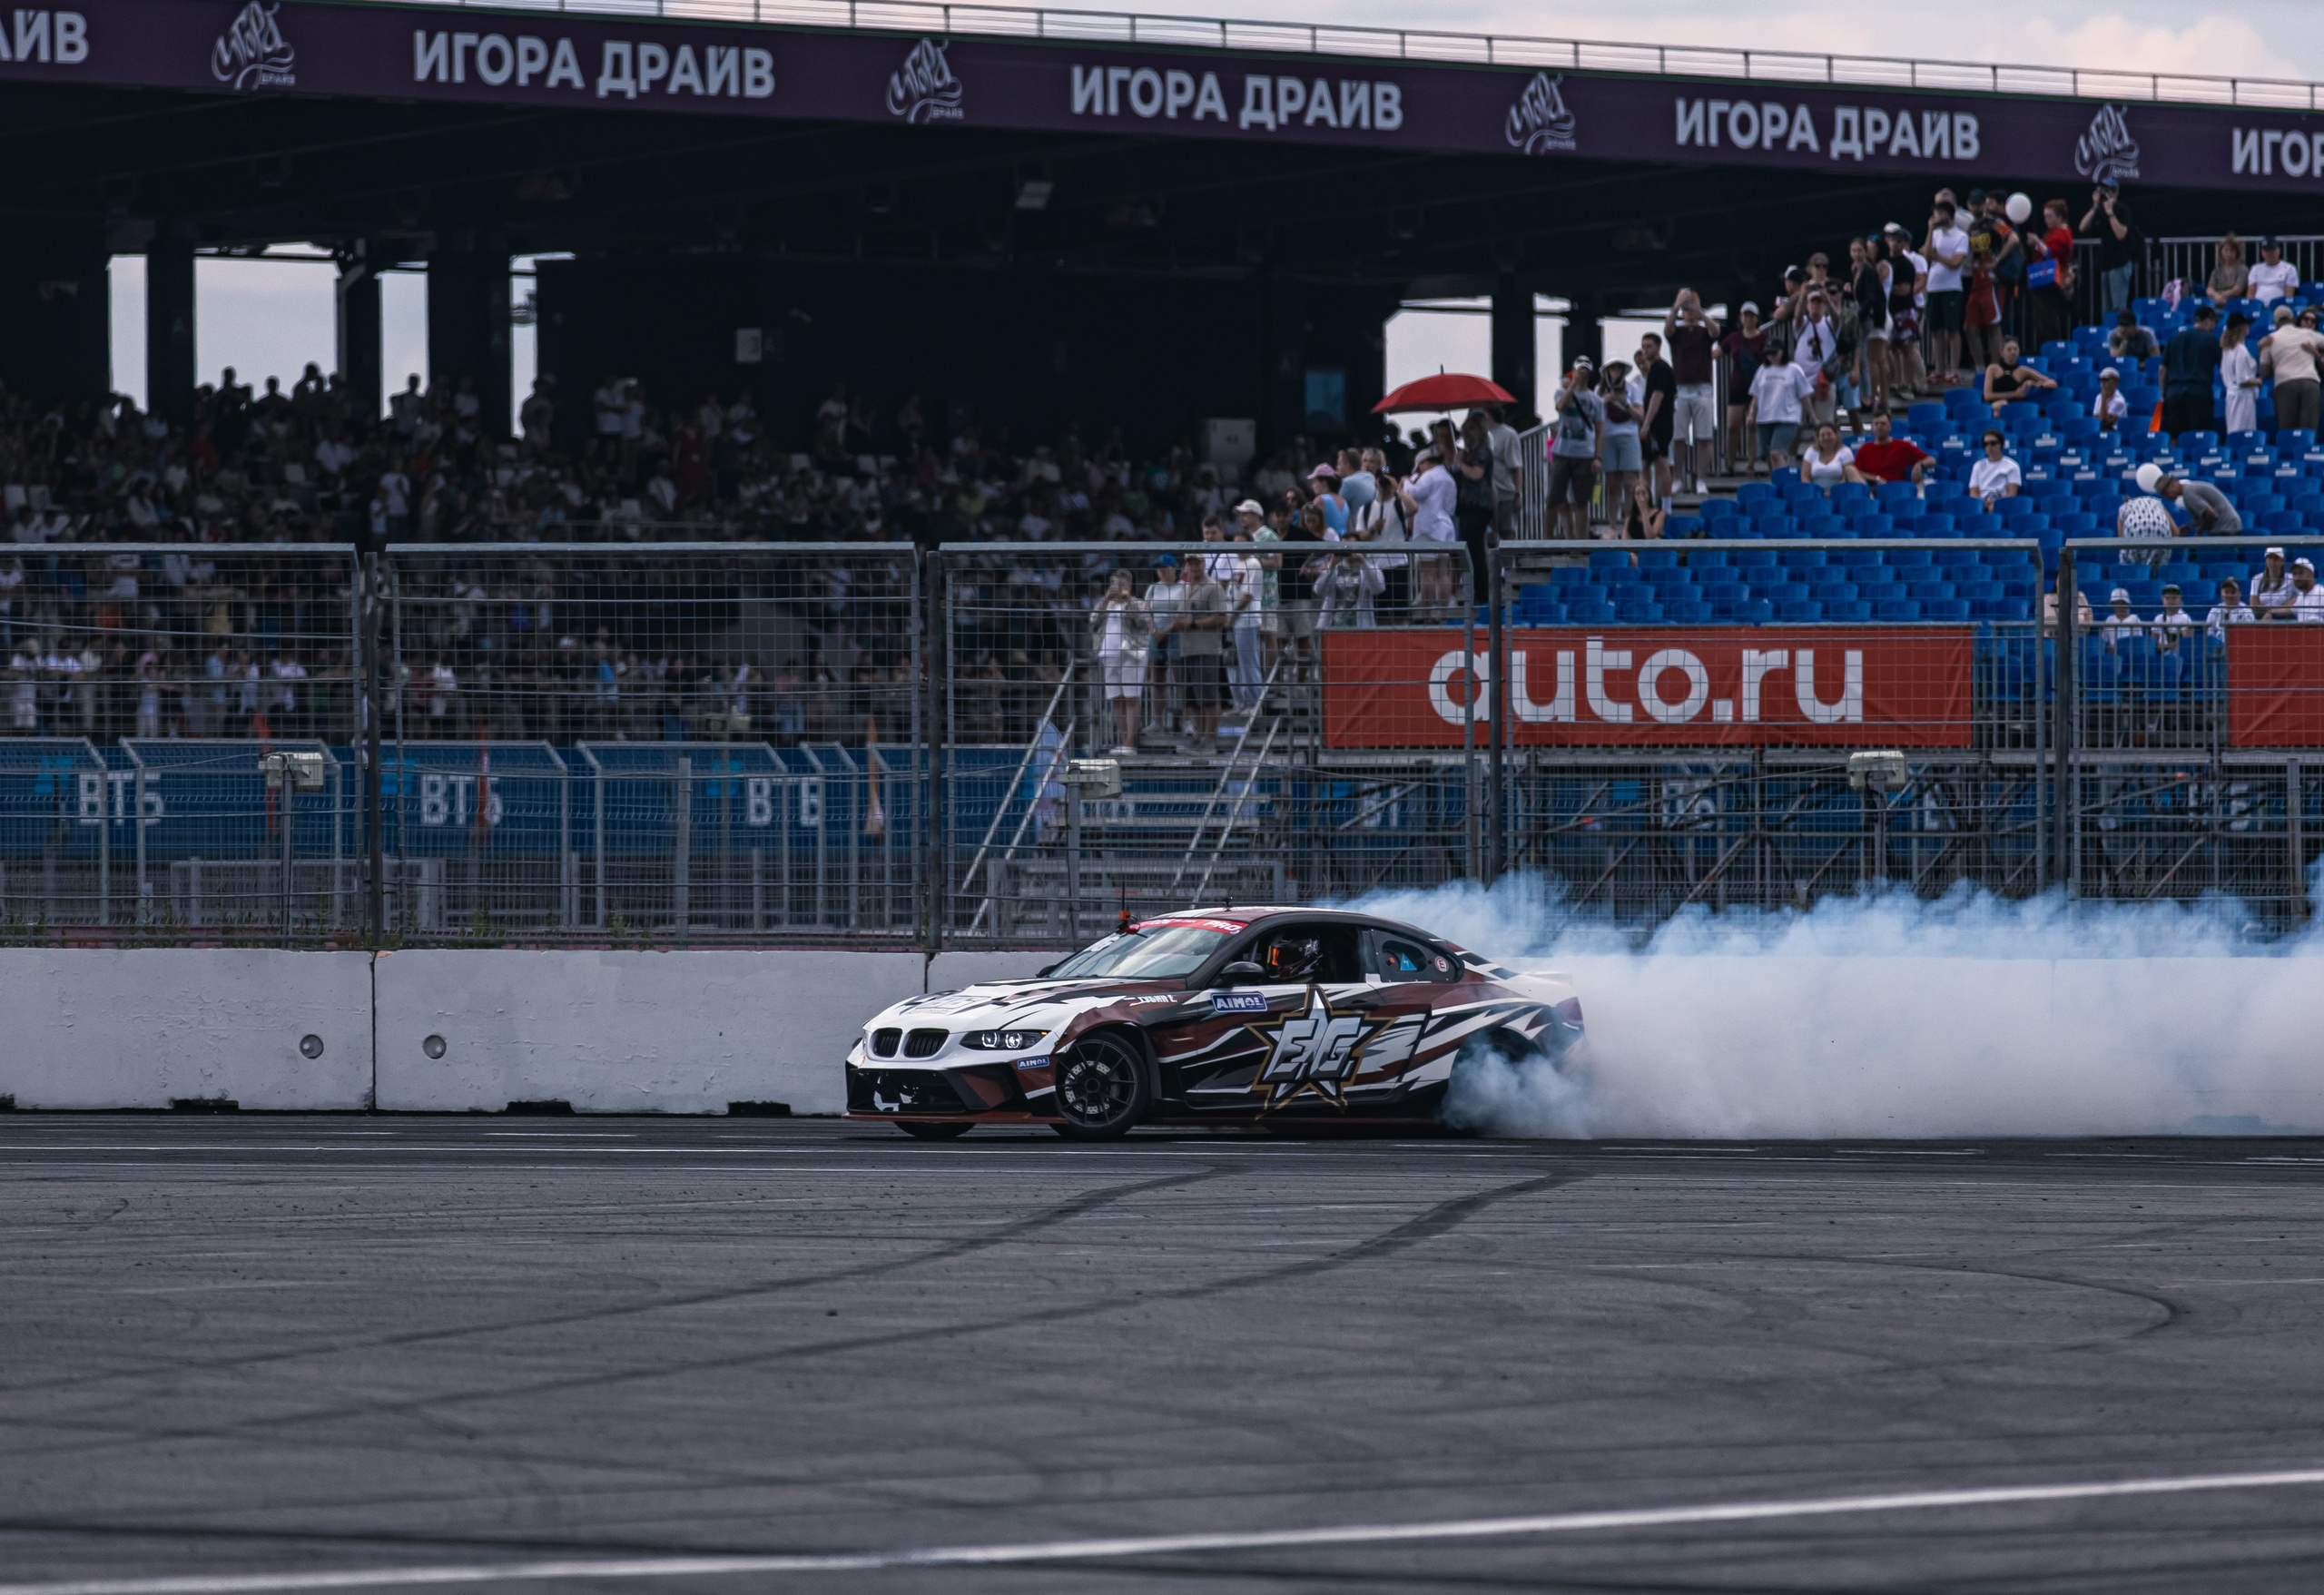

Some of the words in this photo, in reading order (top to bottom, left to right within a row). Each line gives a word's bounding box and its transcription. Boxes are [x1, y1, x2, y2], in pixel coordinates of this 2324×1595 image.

[414, 29, 586, 89] ИГОРА
[596, 40, 775, 100] ДРАЙВ
[1071, 64, 1229, 122] ИГОРА
[1238, 74, 1404, 132] ДРАЙВ
[1676, 97, 1820, 153] ИГОРА
[1829, 104, 1981, 162] ДРАЙВ
[1428, 635, 1864, 725] auto.ru
[1216, 997, 1264, 1009] AIMOL
[1019, 1058, 1047, 1068] AIMOL
